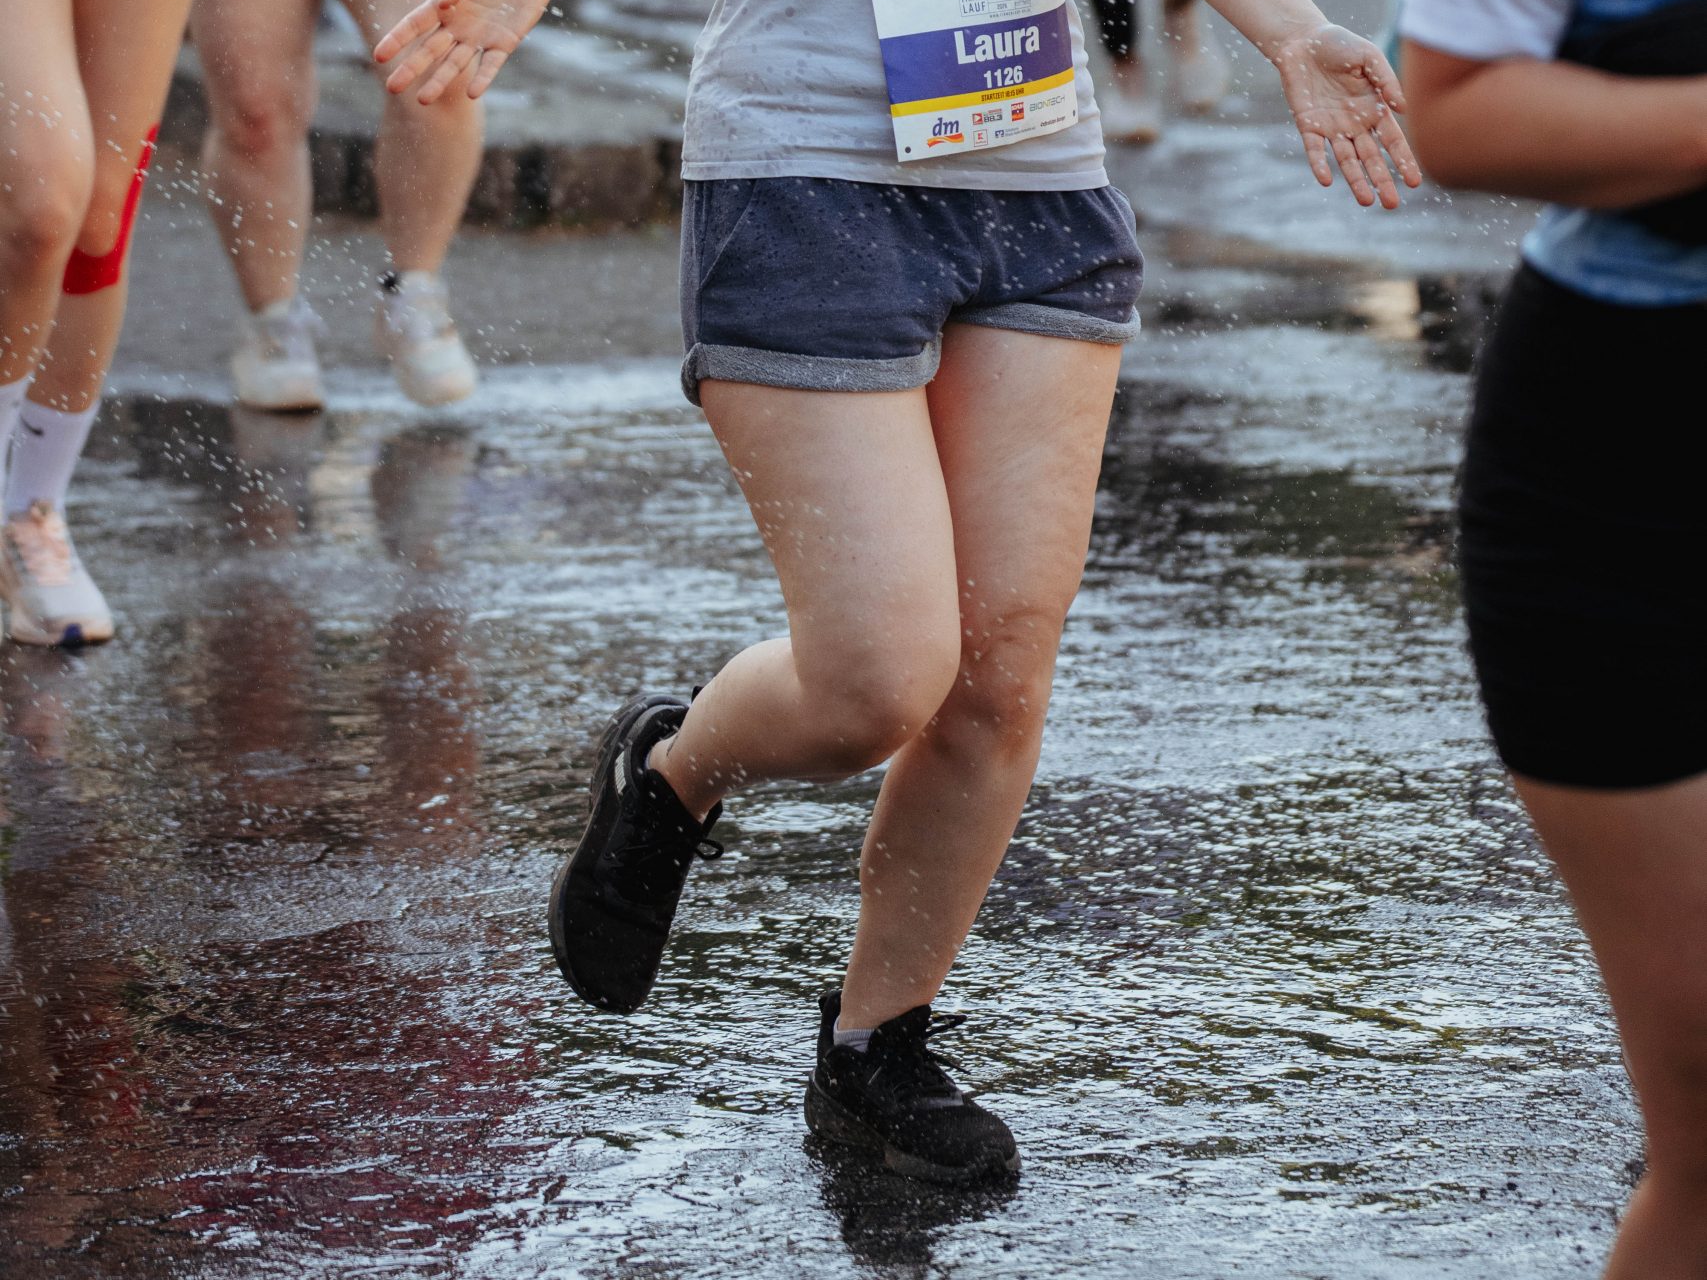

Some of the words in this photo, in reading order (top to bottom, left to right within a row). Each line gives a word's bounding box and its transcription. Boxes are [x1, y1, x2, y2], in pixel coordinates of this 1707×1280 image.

[962, 1, 986, 14] LAUF
[954, 25, 1040, 65] Laura
[984, 65, 1023, 89] 1126
[1029, 96, 1065, 112] BIONTECH
[932, 117, 960, 136] dm
